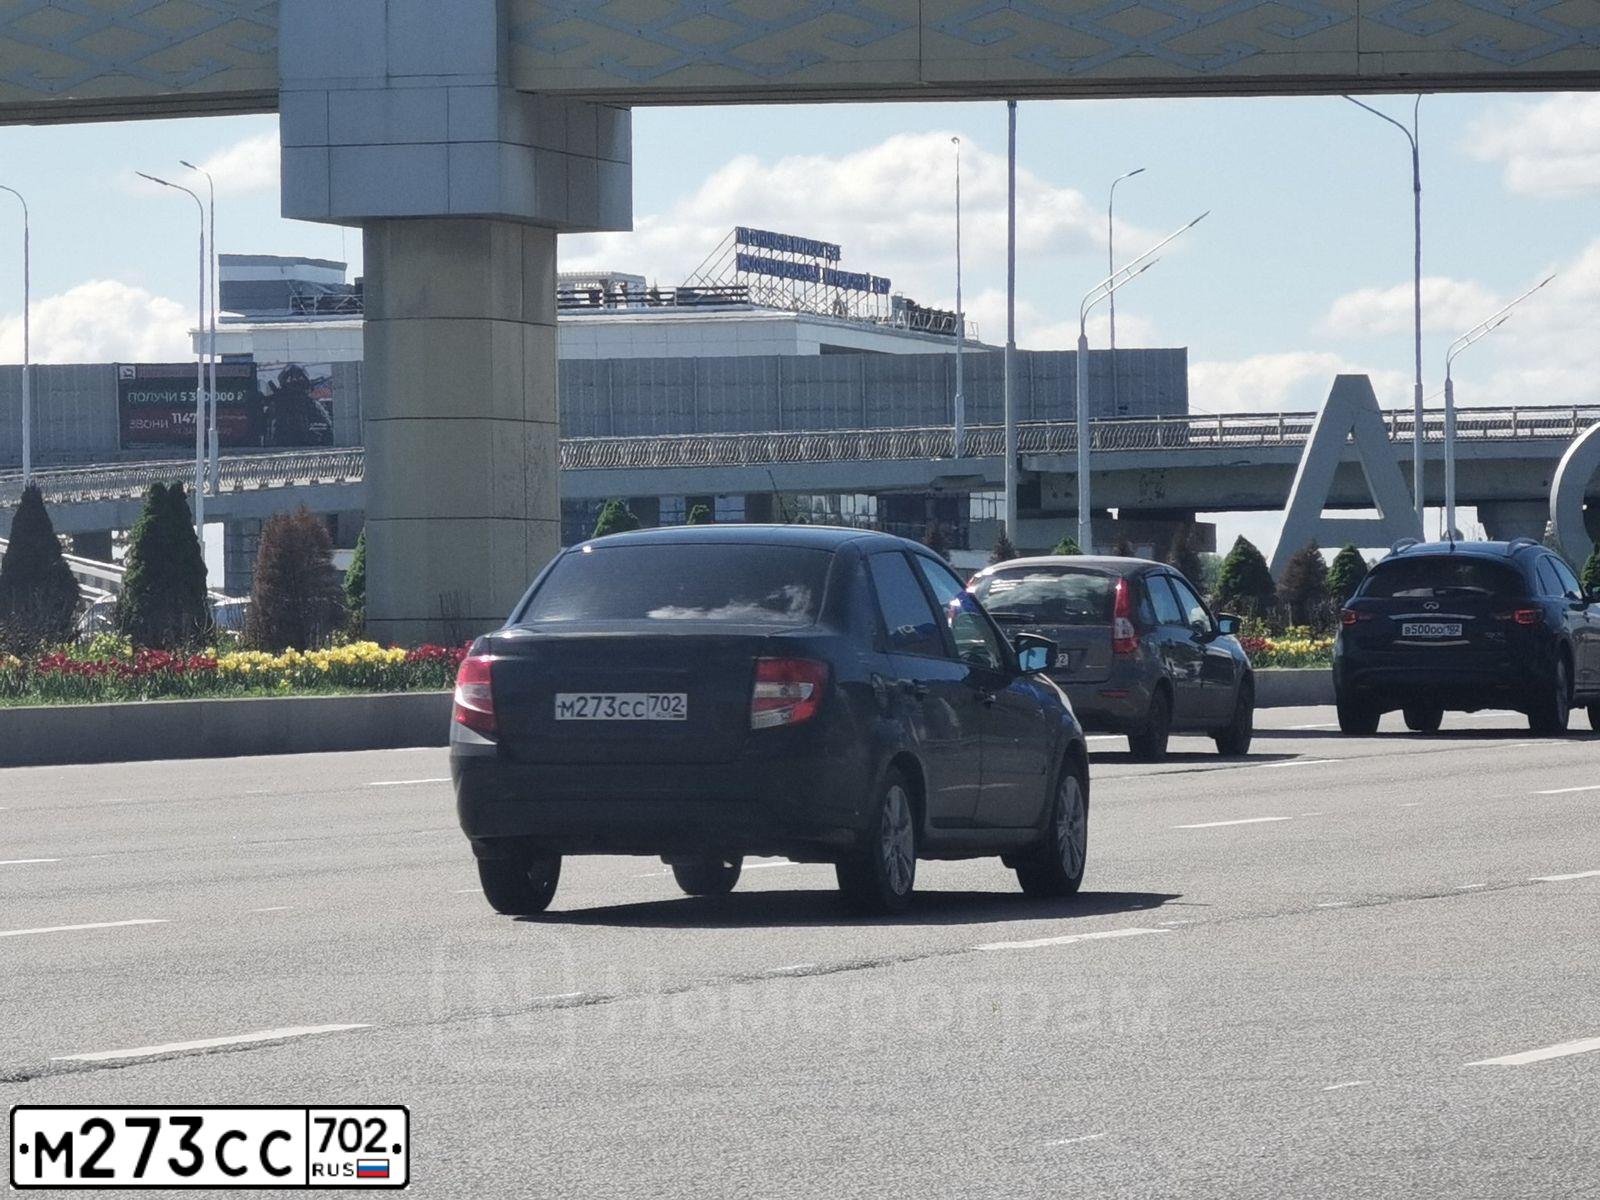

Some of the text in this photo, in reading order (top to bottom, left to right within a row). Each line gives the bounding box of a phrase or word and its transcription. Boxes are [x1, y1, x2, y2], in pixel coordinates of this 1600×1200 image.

[128, 391, 178, 403] ПОЛУЧИ
[180, 392, 187, 402] 5
[129, 419, 169, 429] ЗВОНИ
[560, 696, 682, 718] М273СС 702
